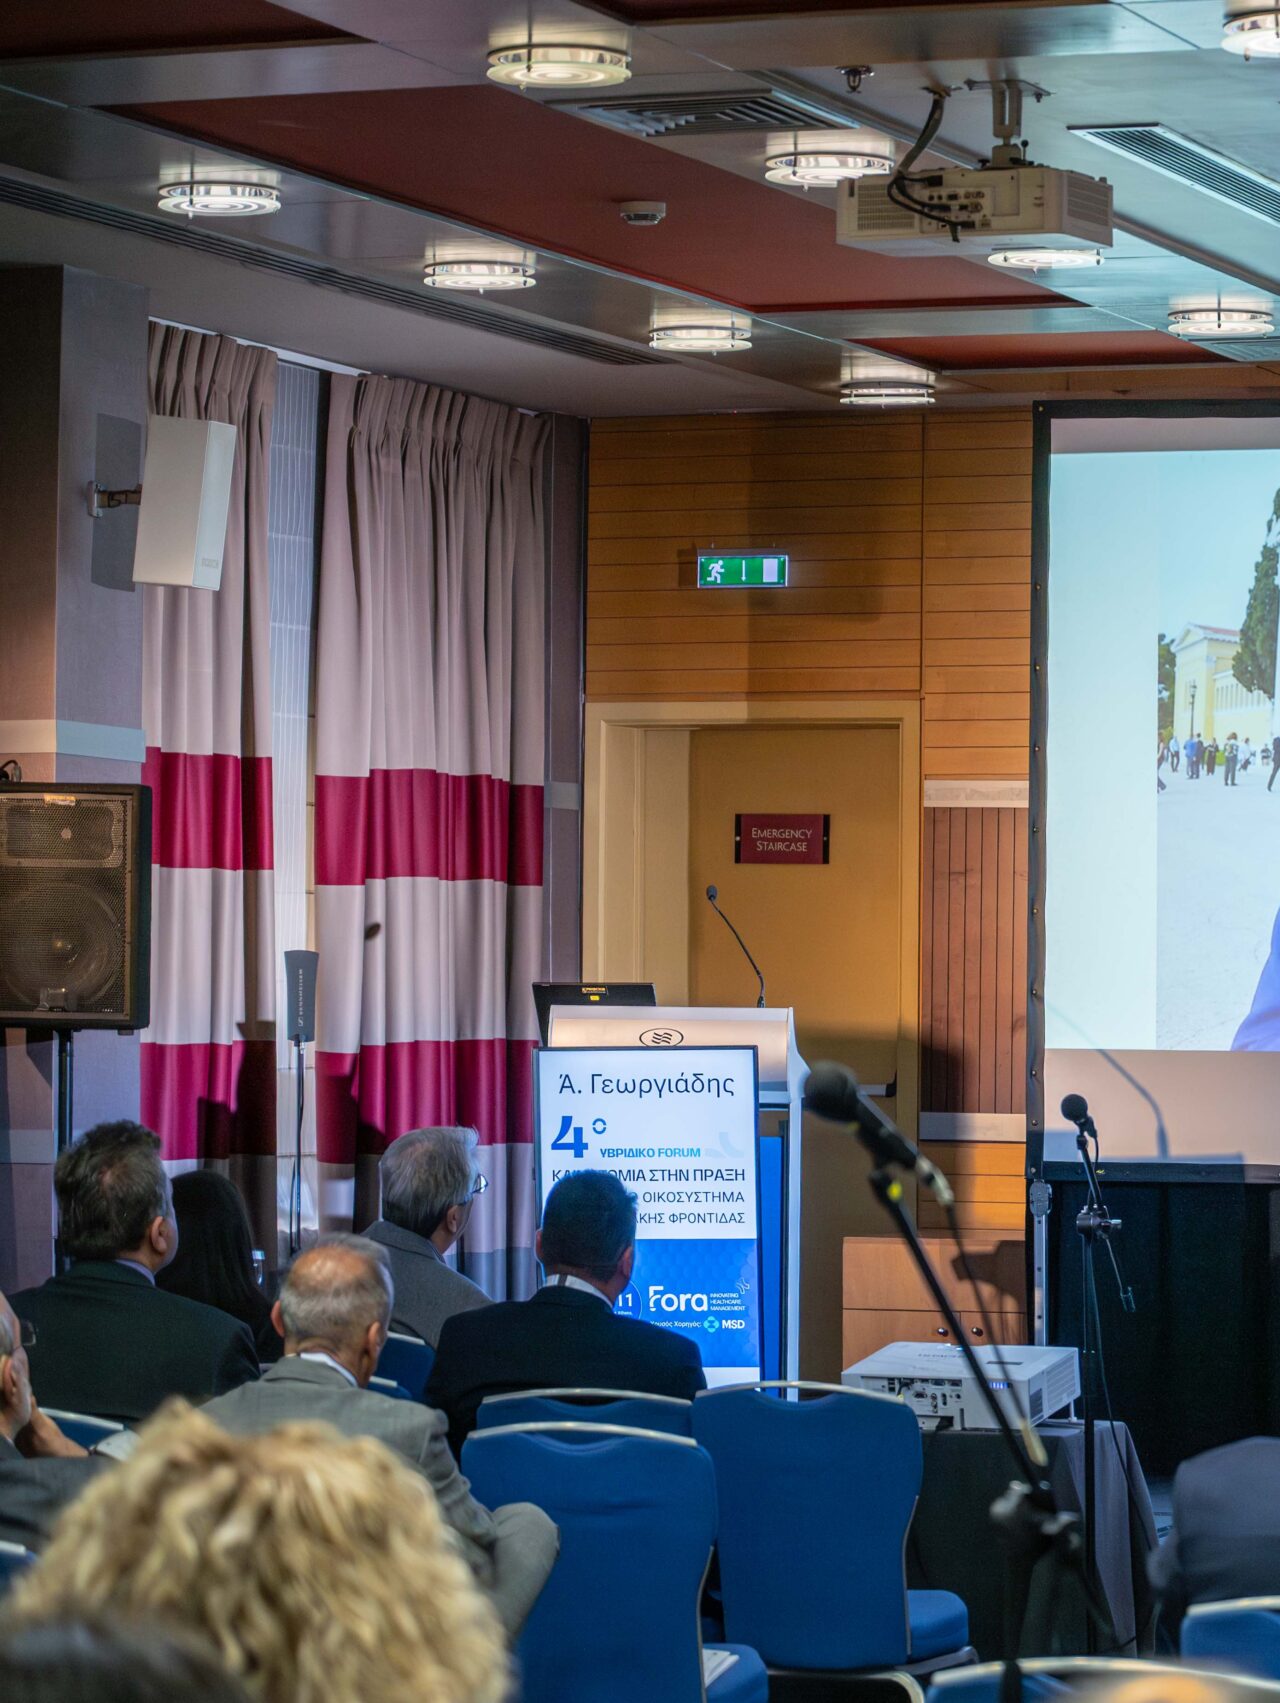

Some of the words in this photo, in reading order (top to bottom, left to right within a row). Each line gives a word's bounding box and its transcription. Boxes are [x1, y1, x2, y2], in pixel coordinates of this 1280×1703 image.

[751, 827, 812, 839] EMERGENCY
[756, 840, 808, 852] STAIRCASE
[591, 1072, 736, 1098] Γεωργιάδης
[599, 1148, 655, 1158] ΥΒΡΙΔΙΚΟ
[657, 1147, 701, 1158] FORUM
[649, 1169, 690, 1182] ΣΤΗΝ
[693, 1169, 746, 1182] ΠΡΑΞΗ
[642, 1191, 745, 1203] ΟΙΚΟΣΥΣΤΗΜΑ
[669, 1212, 746, 1224] ΦΡΟΝΤΙΔΑΣ
[648, 1285, 708, 1312] Fora
[721, 1319, 746, 1329] MSD
